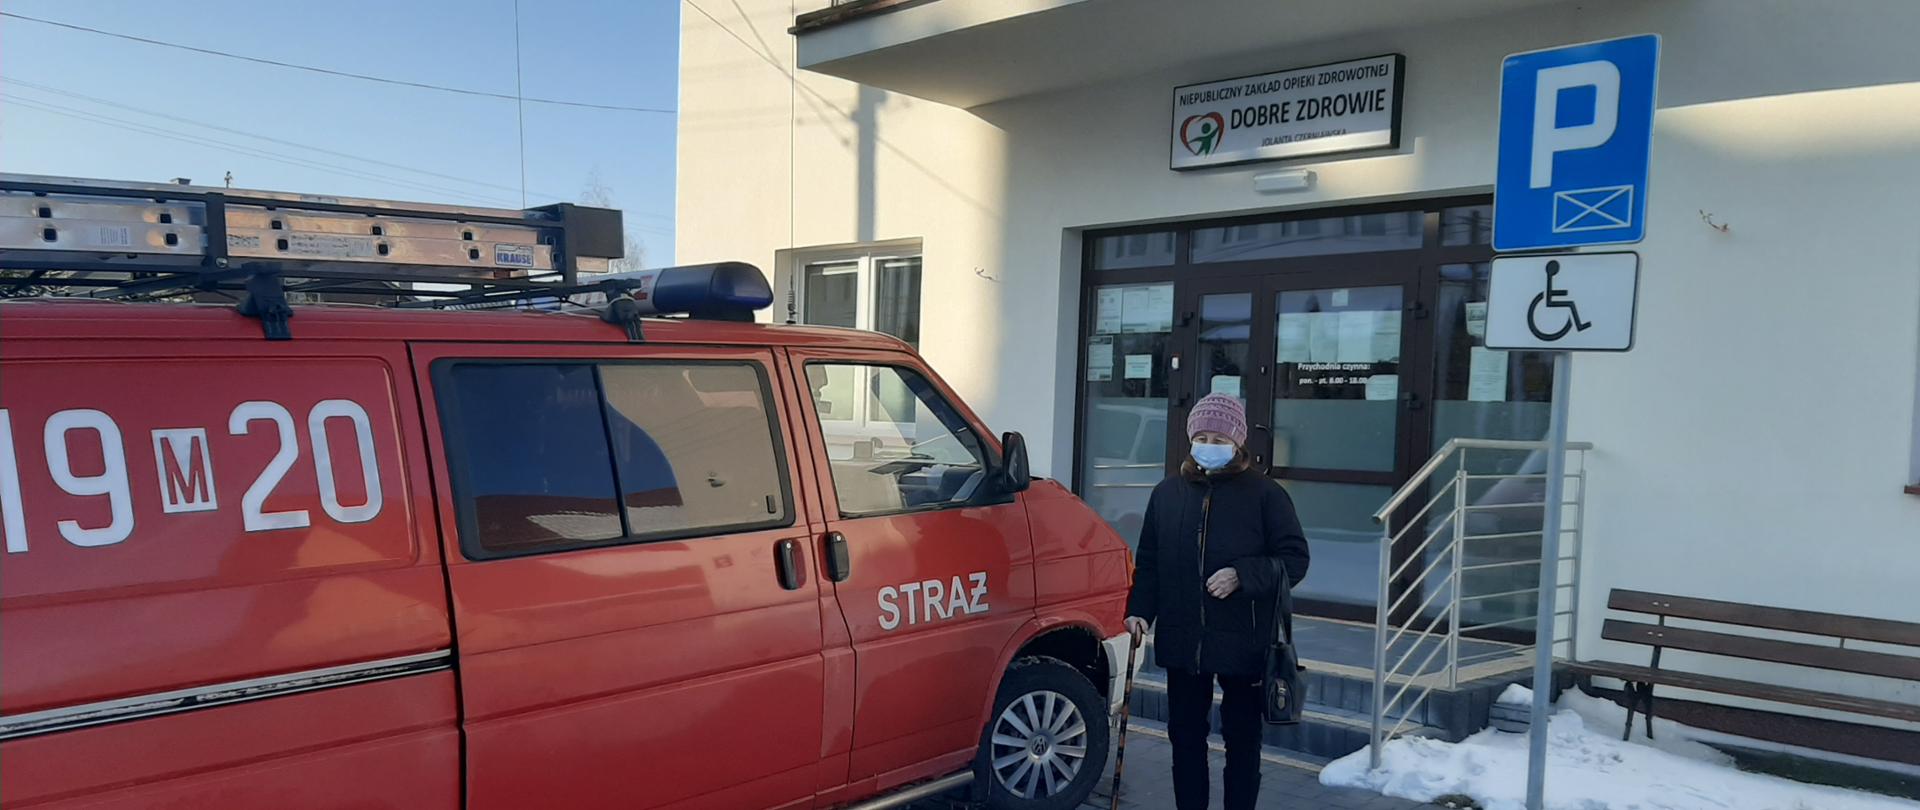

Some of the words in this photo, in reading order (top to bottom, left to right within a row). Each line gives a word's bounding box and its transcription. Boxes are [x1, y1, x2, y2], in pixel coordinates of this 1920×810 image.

[1180, 86, 1243, 106] NIEPUBLICZNY
[1245, 79, 1281, 96] ZAKŁAD
[1283, 73, 1316, 90] OPIEKI
[1318, 63, 1389, 85] ZDROWOTNEJ
[1230, 102, 1290, 130] DOBRE
[1295, 88, 1386, 121] ZDROWIE
[1529, 60, 1621, 189] P
[1261, 134, 1292, 147] JOLANTA
[496, 252, 532, 265] KRAUSE
[1297, 362, 1340, 372] Przychodnia
[1342, 363, 1371, 372] czynna:
[1298, 377, 1313, 385] pon.
[158, 433, 212, 508] M
[228, 398, 384, 532] 20
[878, 571, 990, 631] STRAŻ
